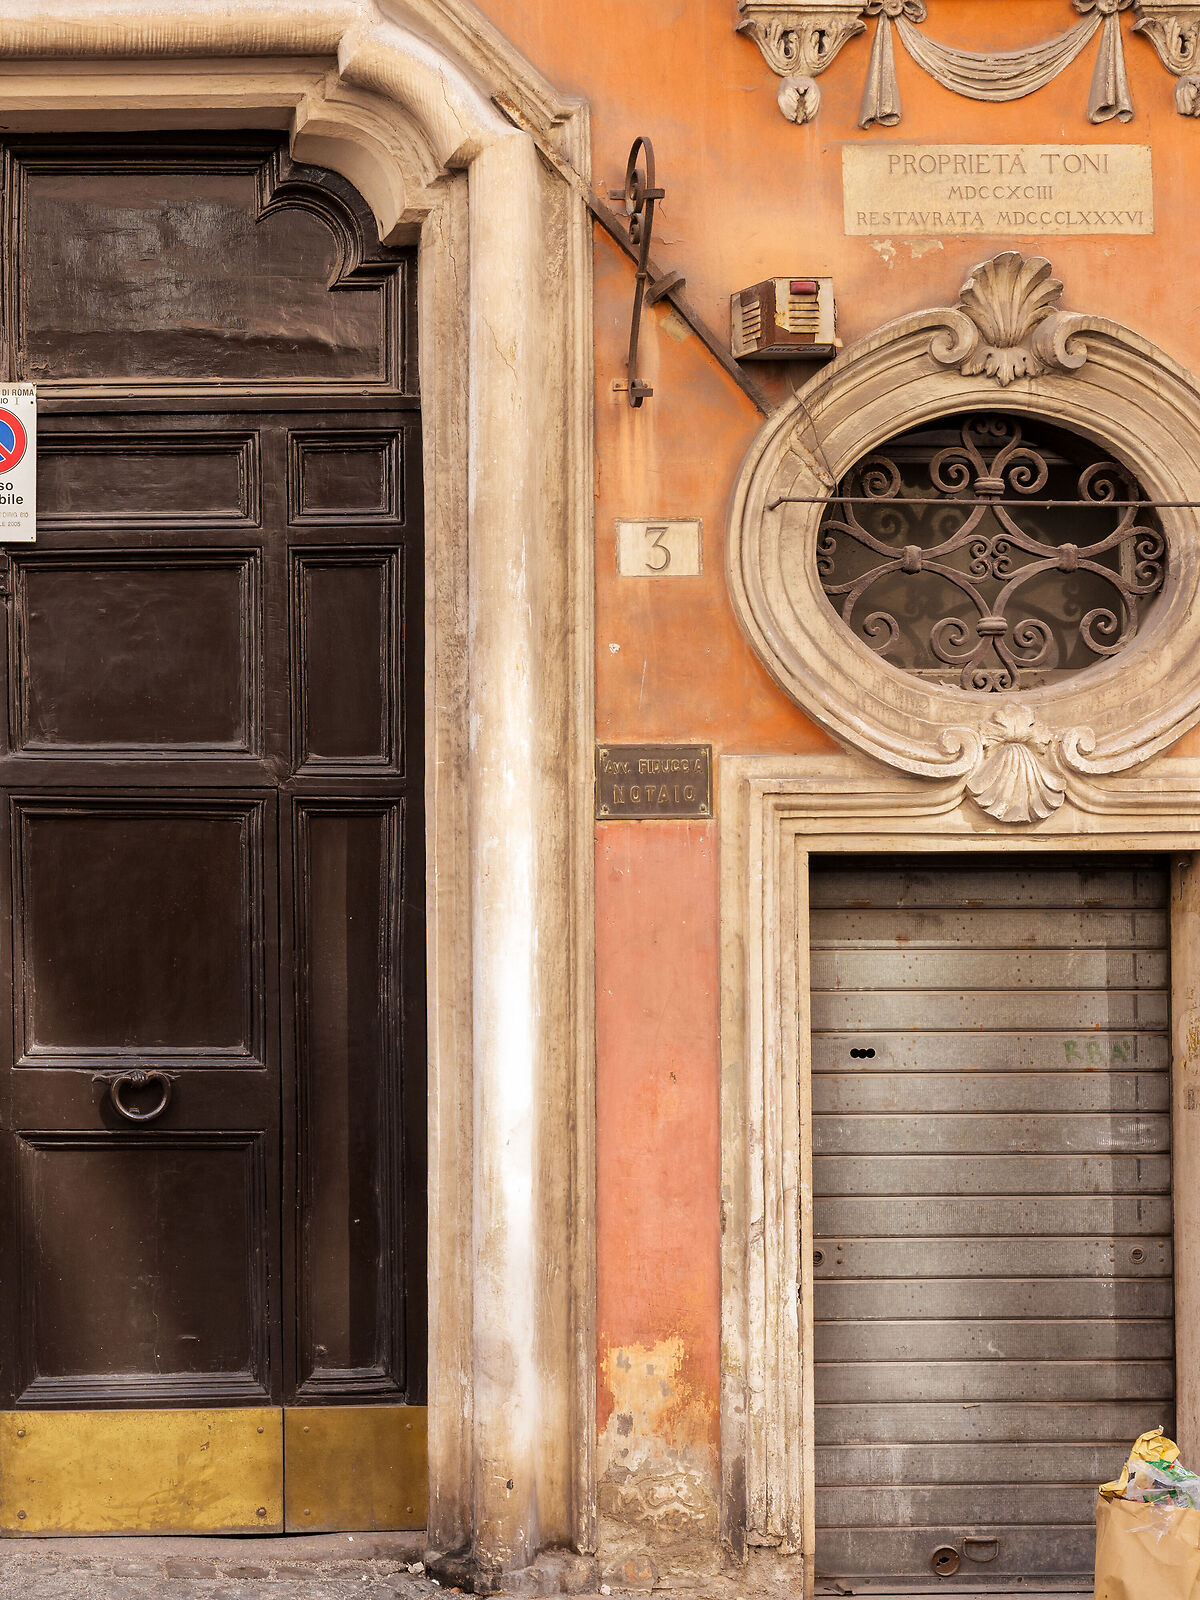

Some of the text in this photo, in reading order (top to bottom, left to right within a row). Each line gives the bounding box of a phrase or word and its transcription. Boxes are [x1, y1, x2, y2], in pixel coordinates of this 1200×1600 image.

[1040, 153, 1109, 174] TONI
[948, 185, 1053, 200] MDCCXCIII
[856, 211, 1144, 226] RESTAVRATA MDCCCLXXXVI
[2, 388, 10, 397] DI
[11, 388, 35, 397] ROMA
[644, 526, 671, 572] 3
[613, 784, 695, 804] NOTAIO
